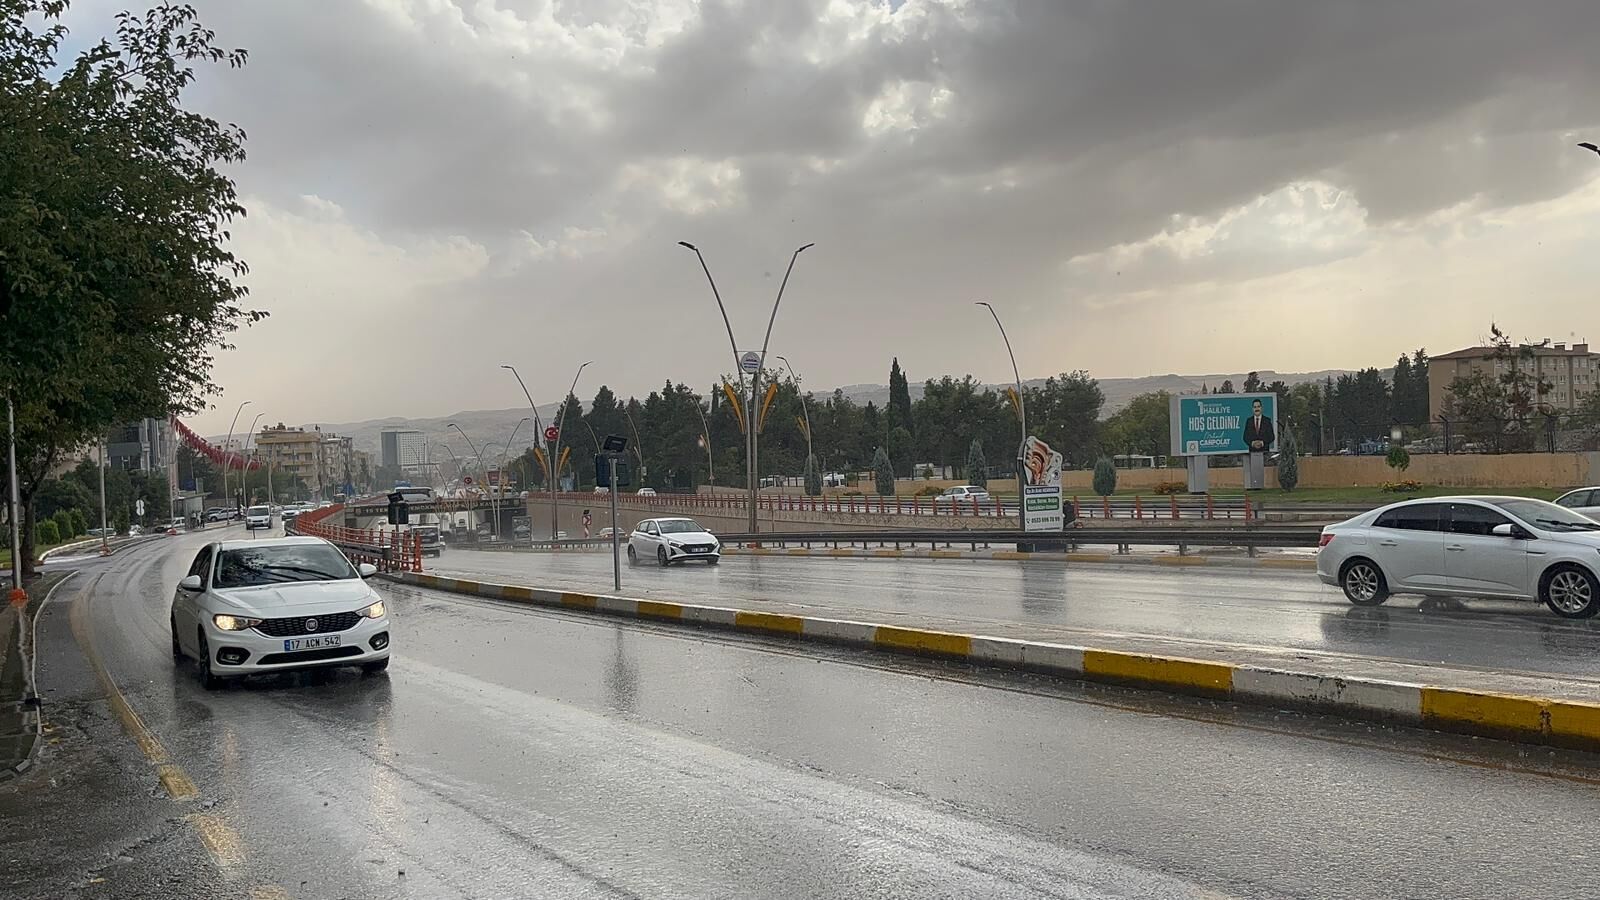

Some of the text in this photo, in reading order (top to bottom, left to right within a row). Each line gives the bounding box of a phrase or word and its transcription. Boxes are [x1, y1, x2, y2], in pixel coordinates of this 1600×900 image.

[1189, 416, 1205, 432] HOŞ
[291, 640, 300, 650] 17
[324, 636, 340, 646] 542
